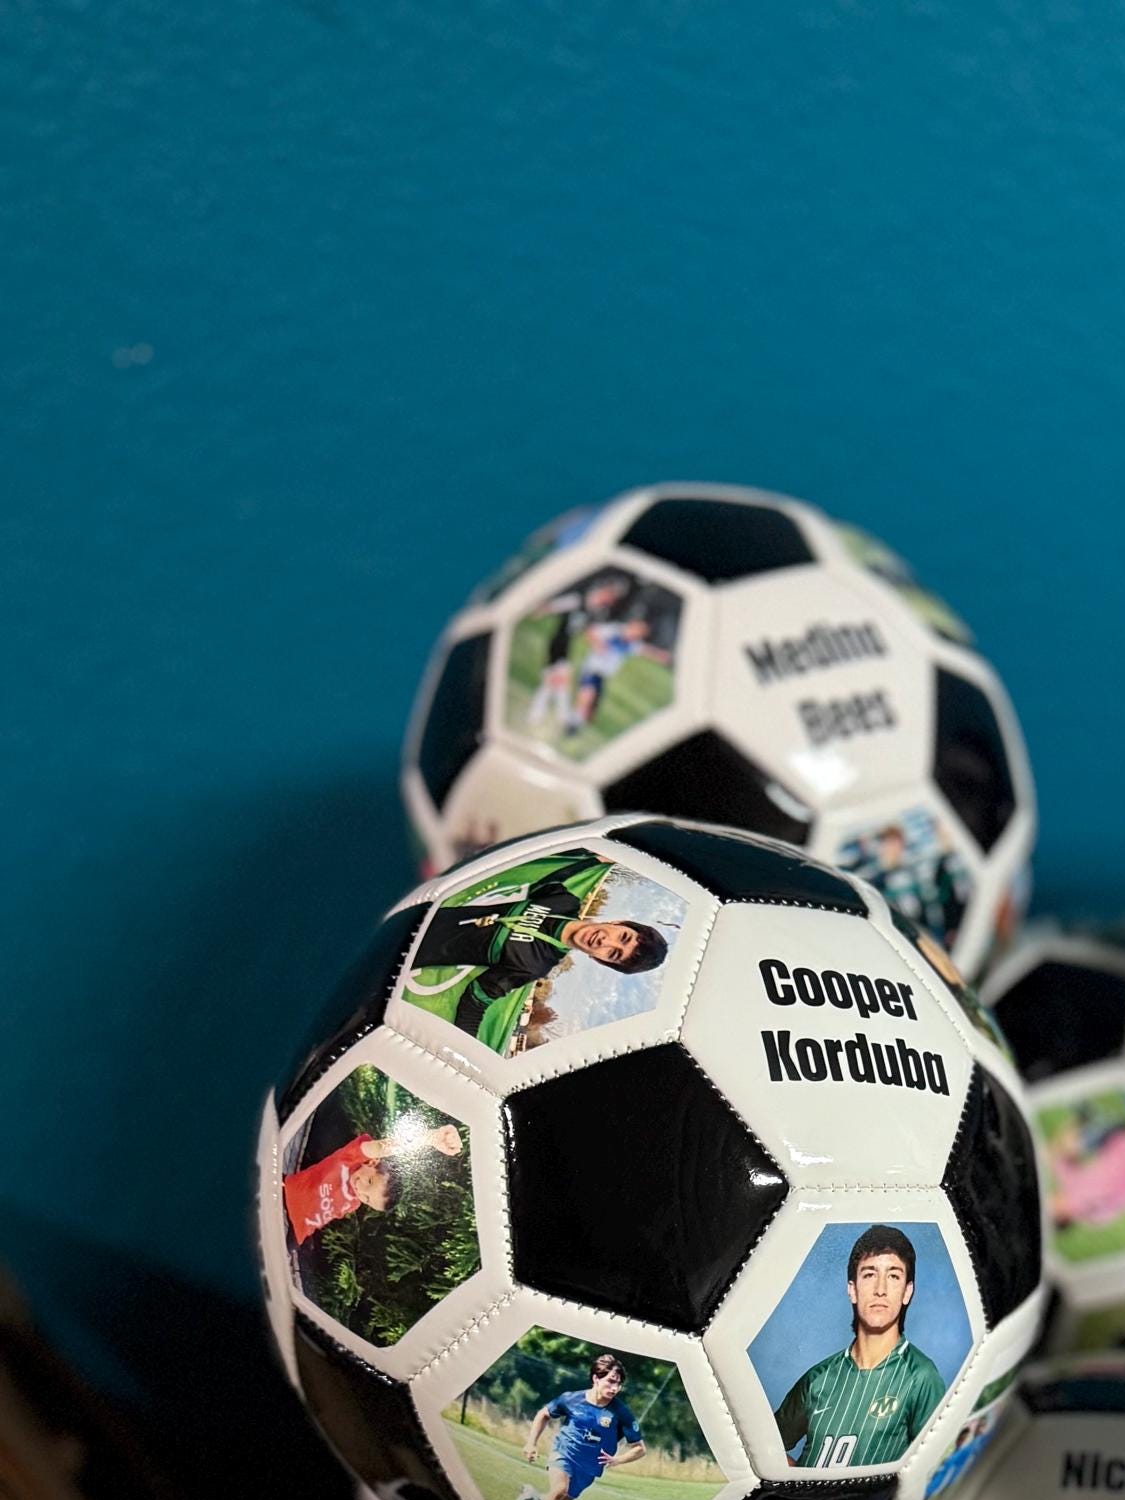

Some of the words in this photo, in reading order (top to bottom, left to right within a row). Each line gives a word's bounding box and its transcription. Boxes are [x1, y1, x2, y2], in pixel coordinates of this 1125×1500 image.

[509, 904, 552, 942] MEDIA
[758, 958, 919, 1021] Cooper
[760, 1030, 950, 1097] Korduba
